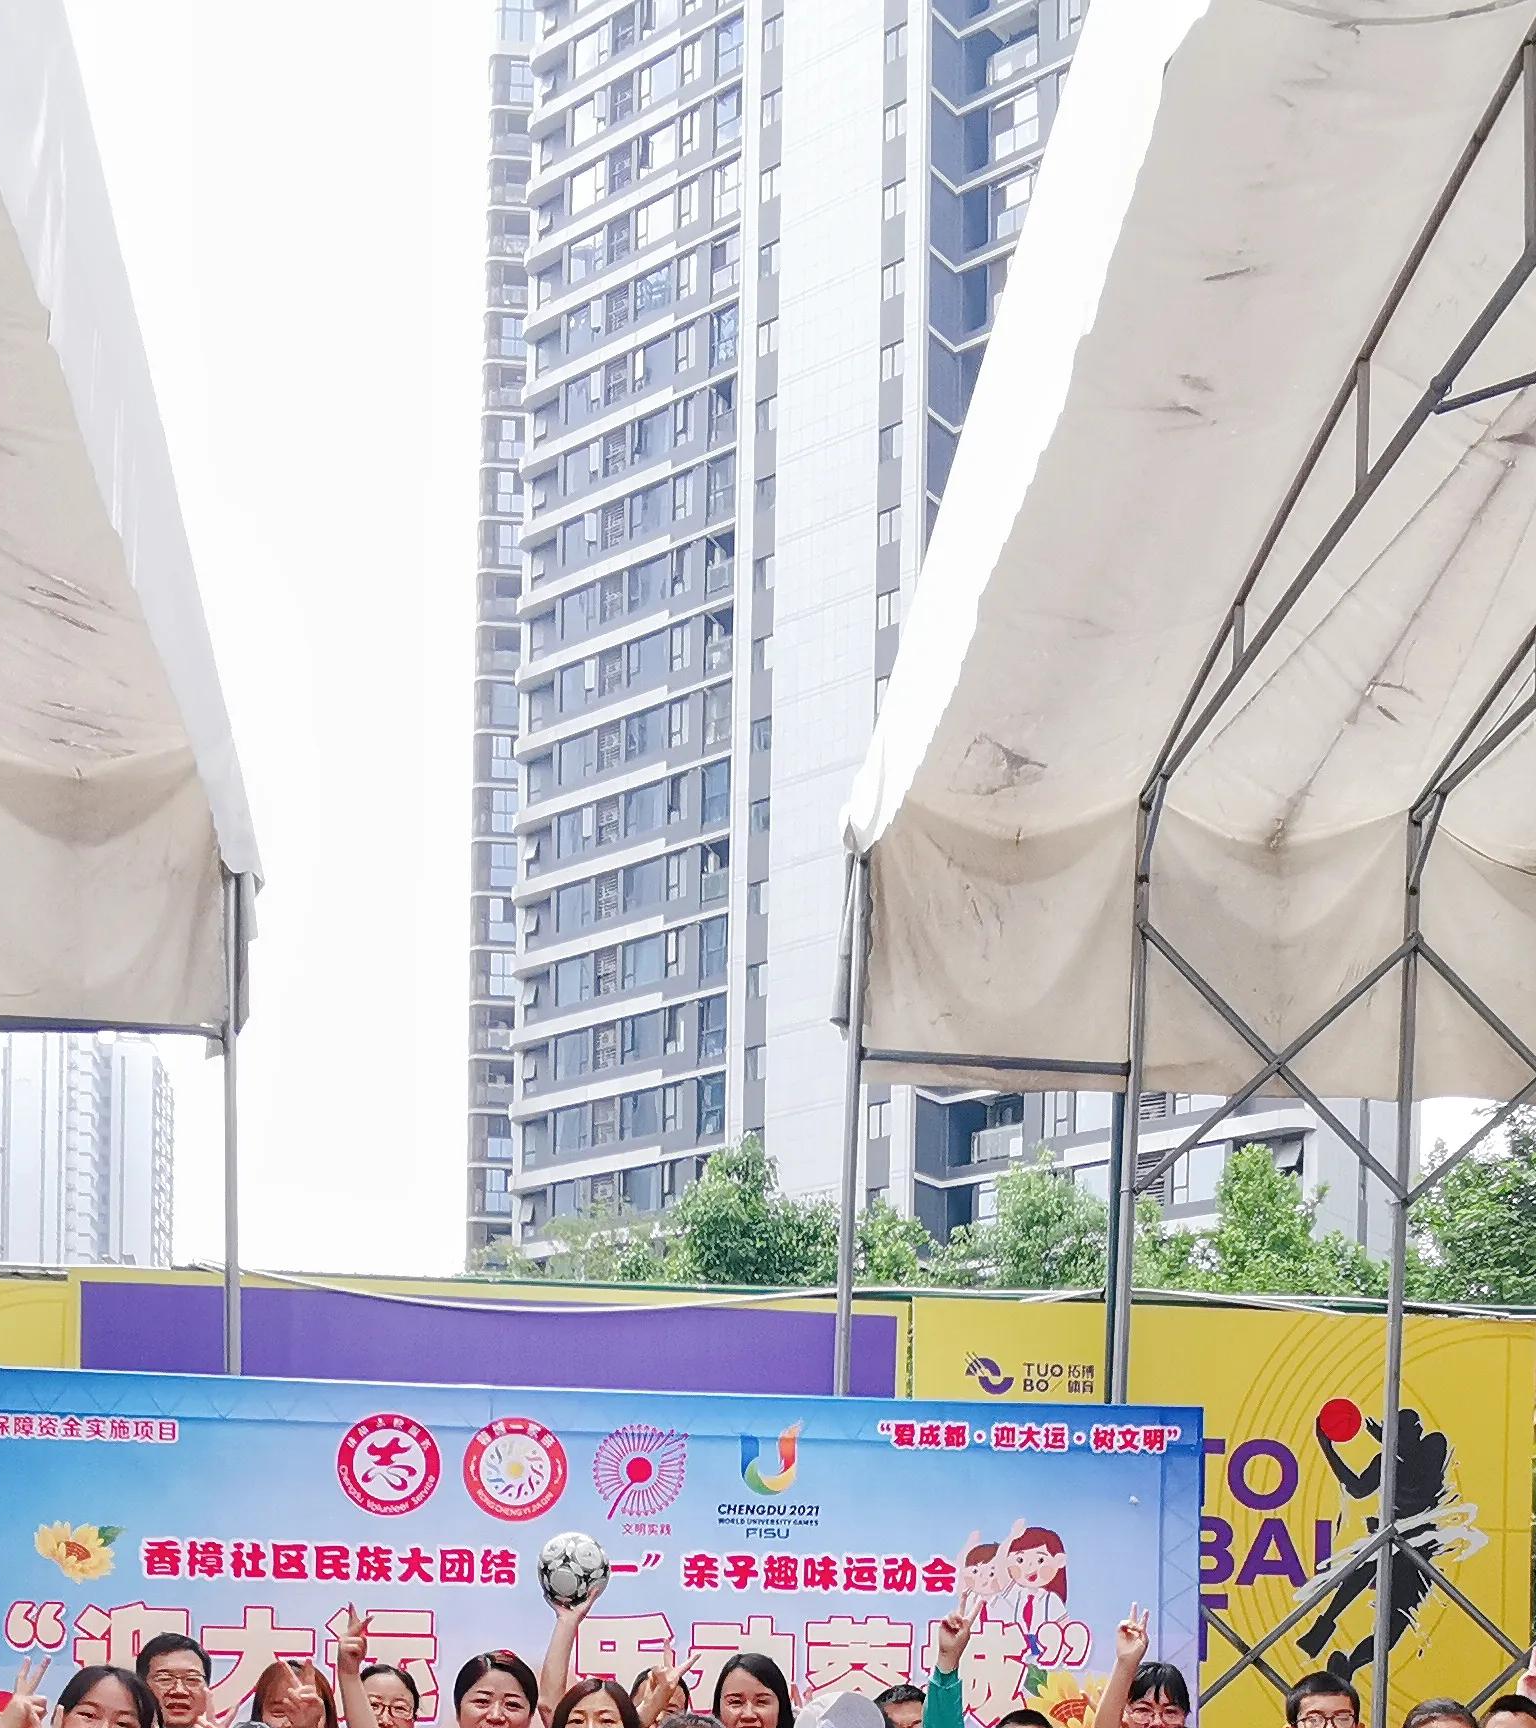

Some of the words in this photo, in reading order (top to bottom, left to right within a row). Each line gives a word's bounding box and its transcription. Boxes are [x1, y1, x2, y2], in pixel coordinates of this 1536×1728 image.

[1023, 1363, 1063, 1377] TUO
[1023, 1379, 1049, 1392] BO
[718, 1503, 786, 1516] CHENGDU
[789, 1505, 820, 1517] 2021
[718, 1517, 745, 1525] WORLD
[747, 1518, 791, 1526] UNIVERSITY
[622, 1523, 672, 1536] 文明实践
[746, 1528, 790, 1539] FISU
[144, 1540, 517, 1586] 香樟社区民族大团结
[683, 1553, 957, 1593] 亲子趣味运动会
